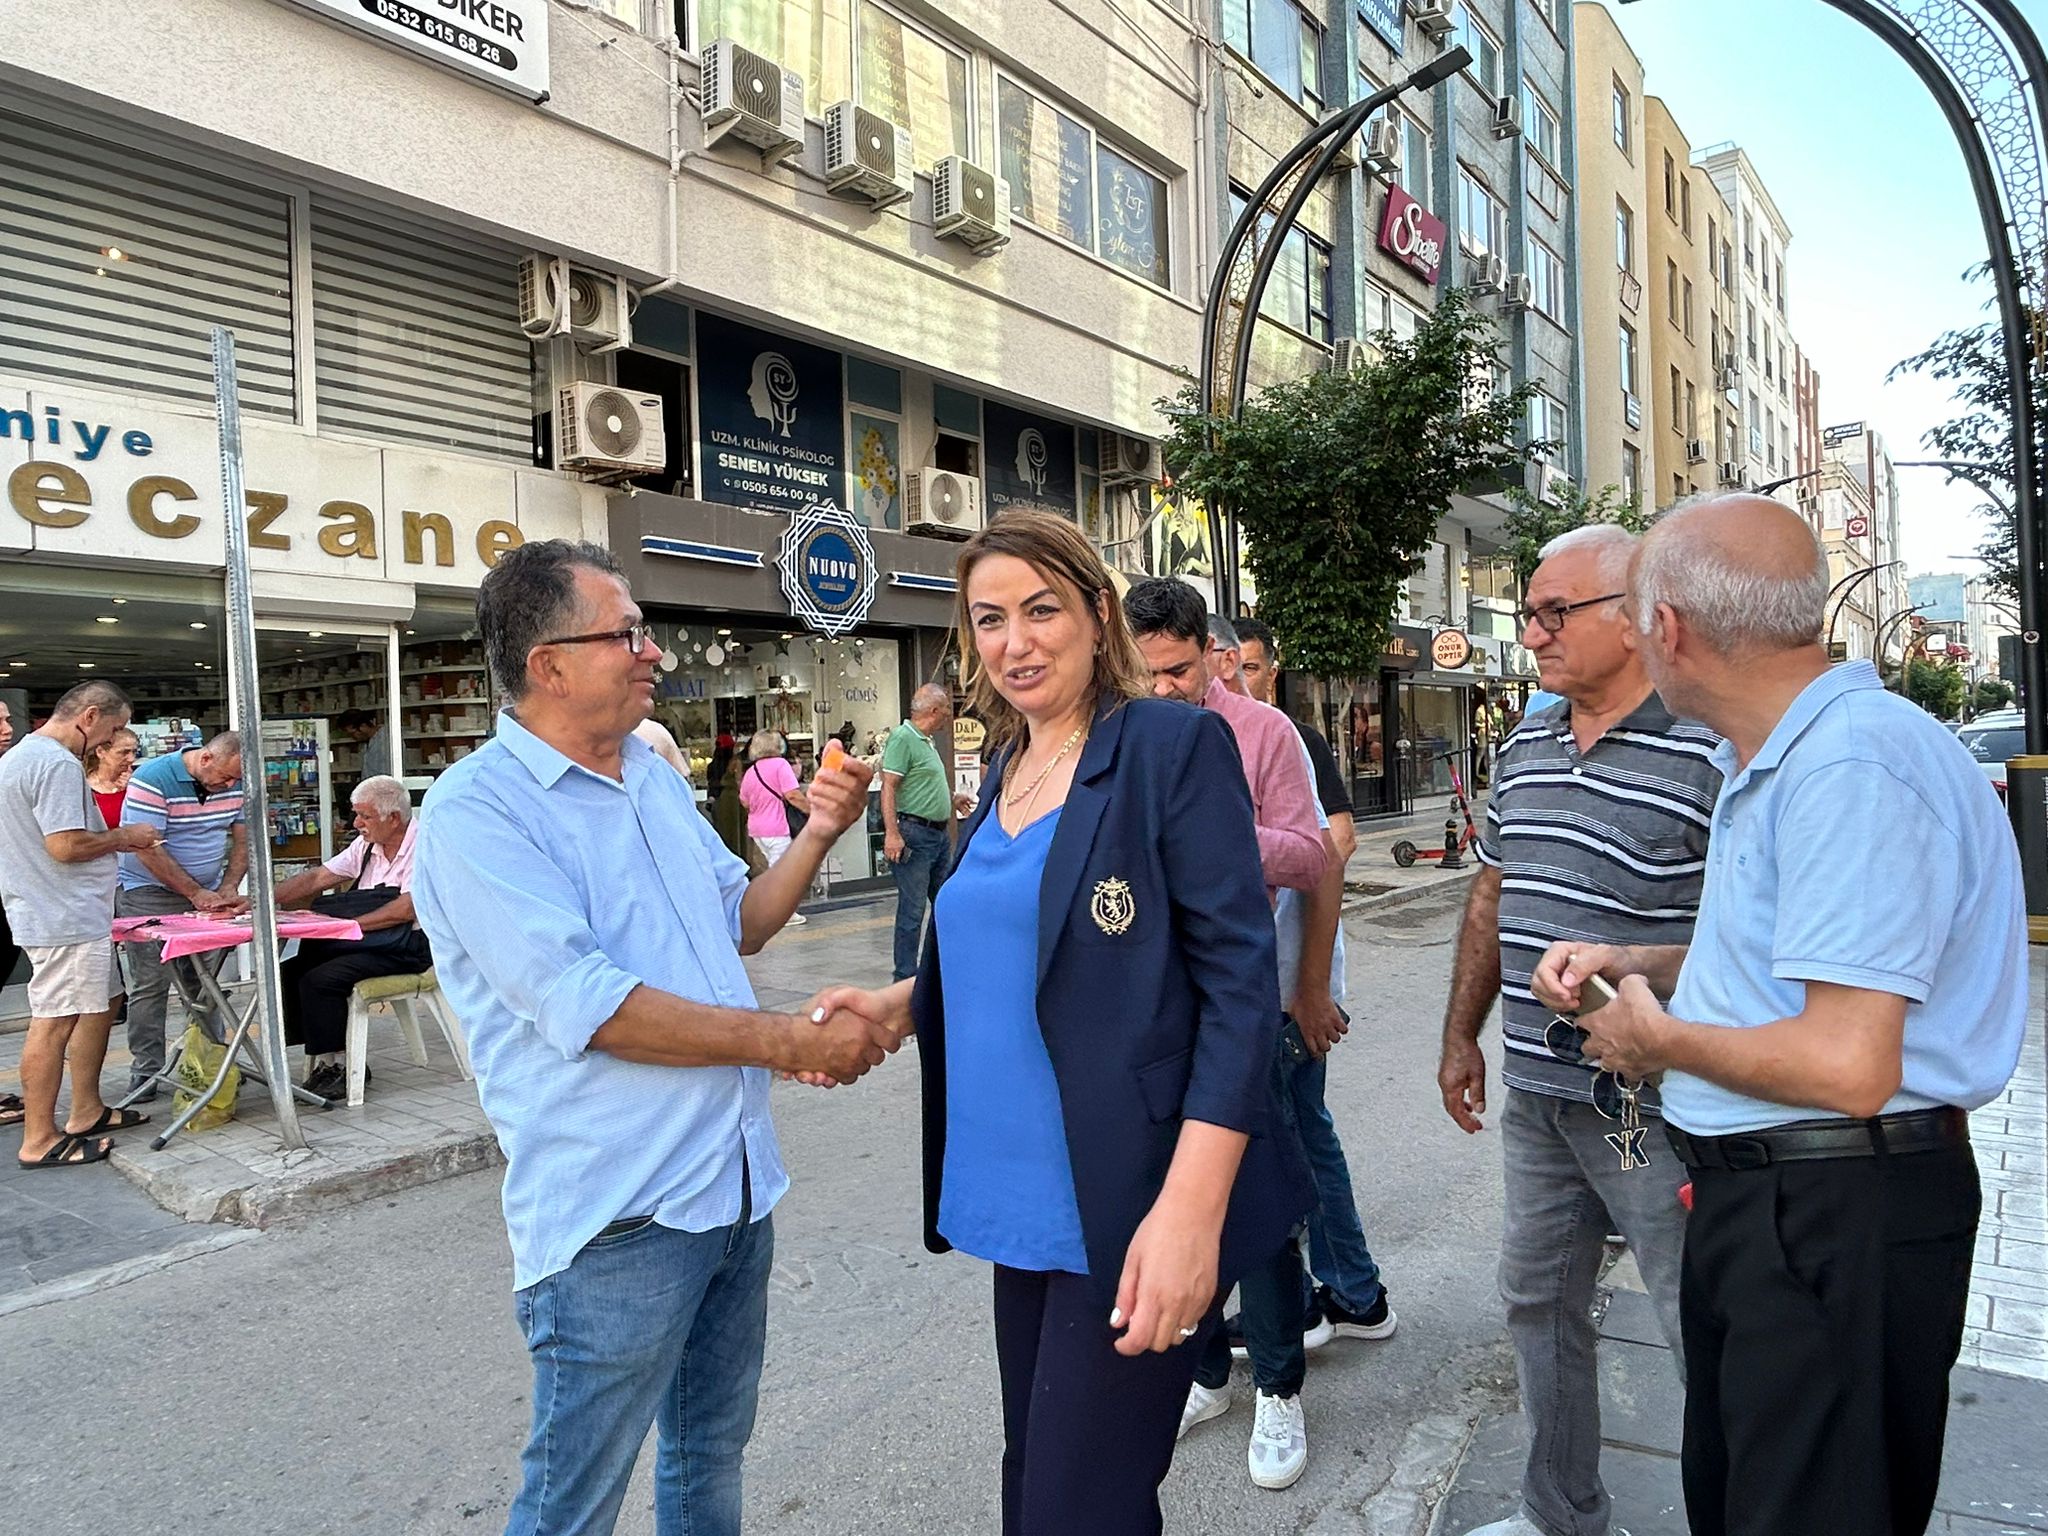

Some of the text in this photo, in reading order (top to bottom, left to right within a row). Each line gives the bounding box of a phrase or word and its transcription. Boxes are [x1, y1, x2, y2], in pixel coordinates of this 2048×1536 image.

[377, 0, 501, 63] 0532 615 68 26
[773, 372, 785, 384] SY
[711, 430, 835, 466] UZM. KLİNİK PSİKOLOG
[718, 453, 829, 487] SENEM YÜKSEK
[741, 480, 818, 503] 0505 654 00 48
[8, 460, 525, 569] eczane
[808, 556, 857, 580] NUOVO
[663, 678, 705, 697] SAAT
[845, 686, 878, 704] GÜMÜŞ
[955, 721, 978, 734] D&P
